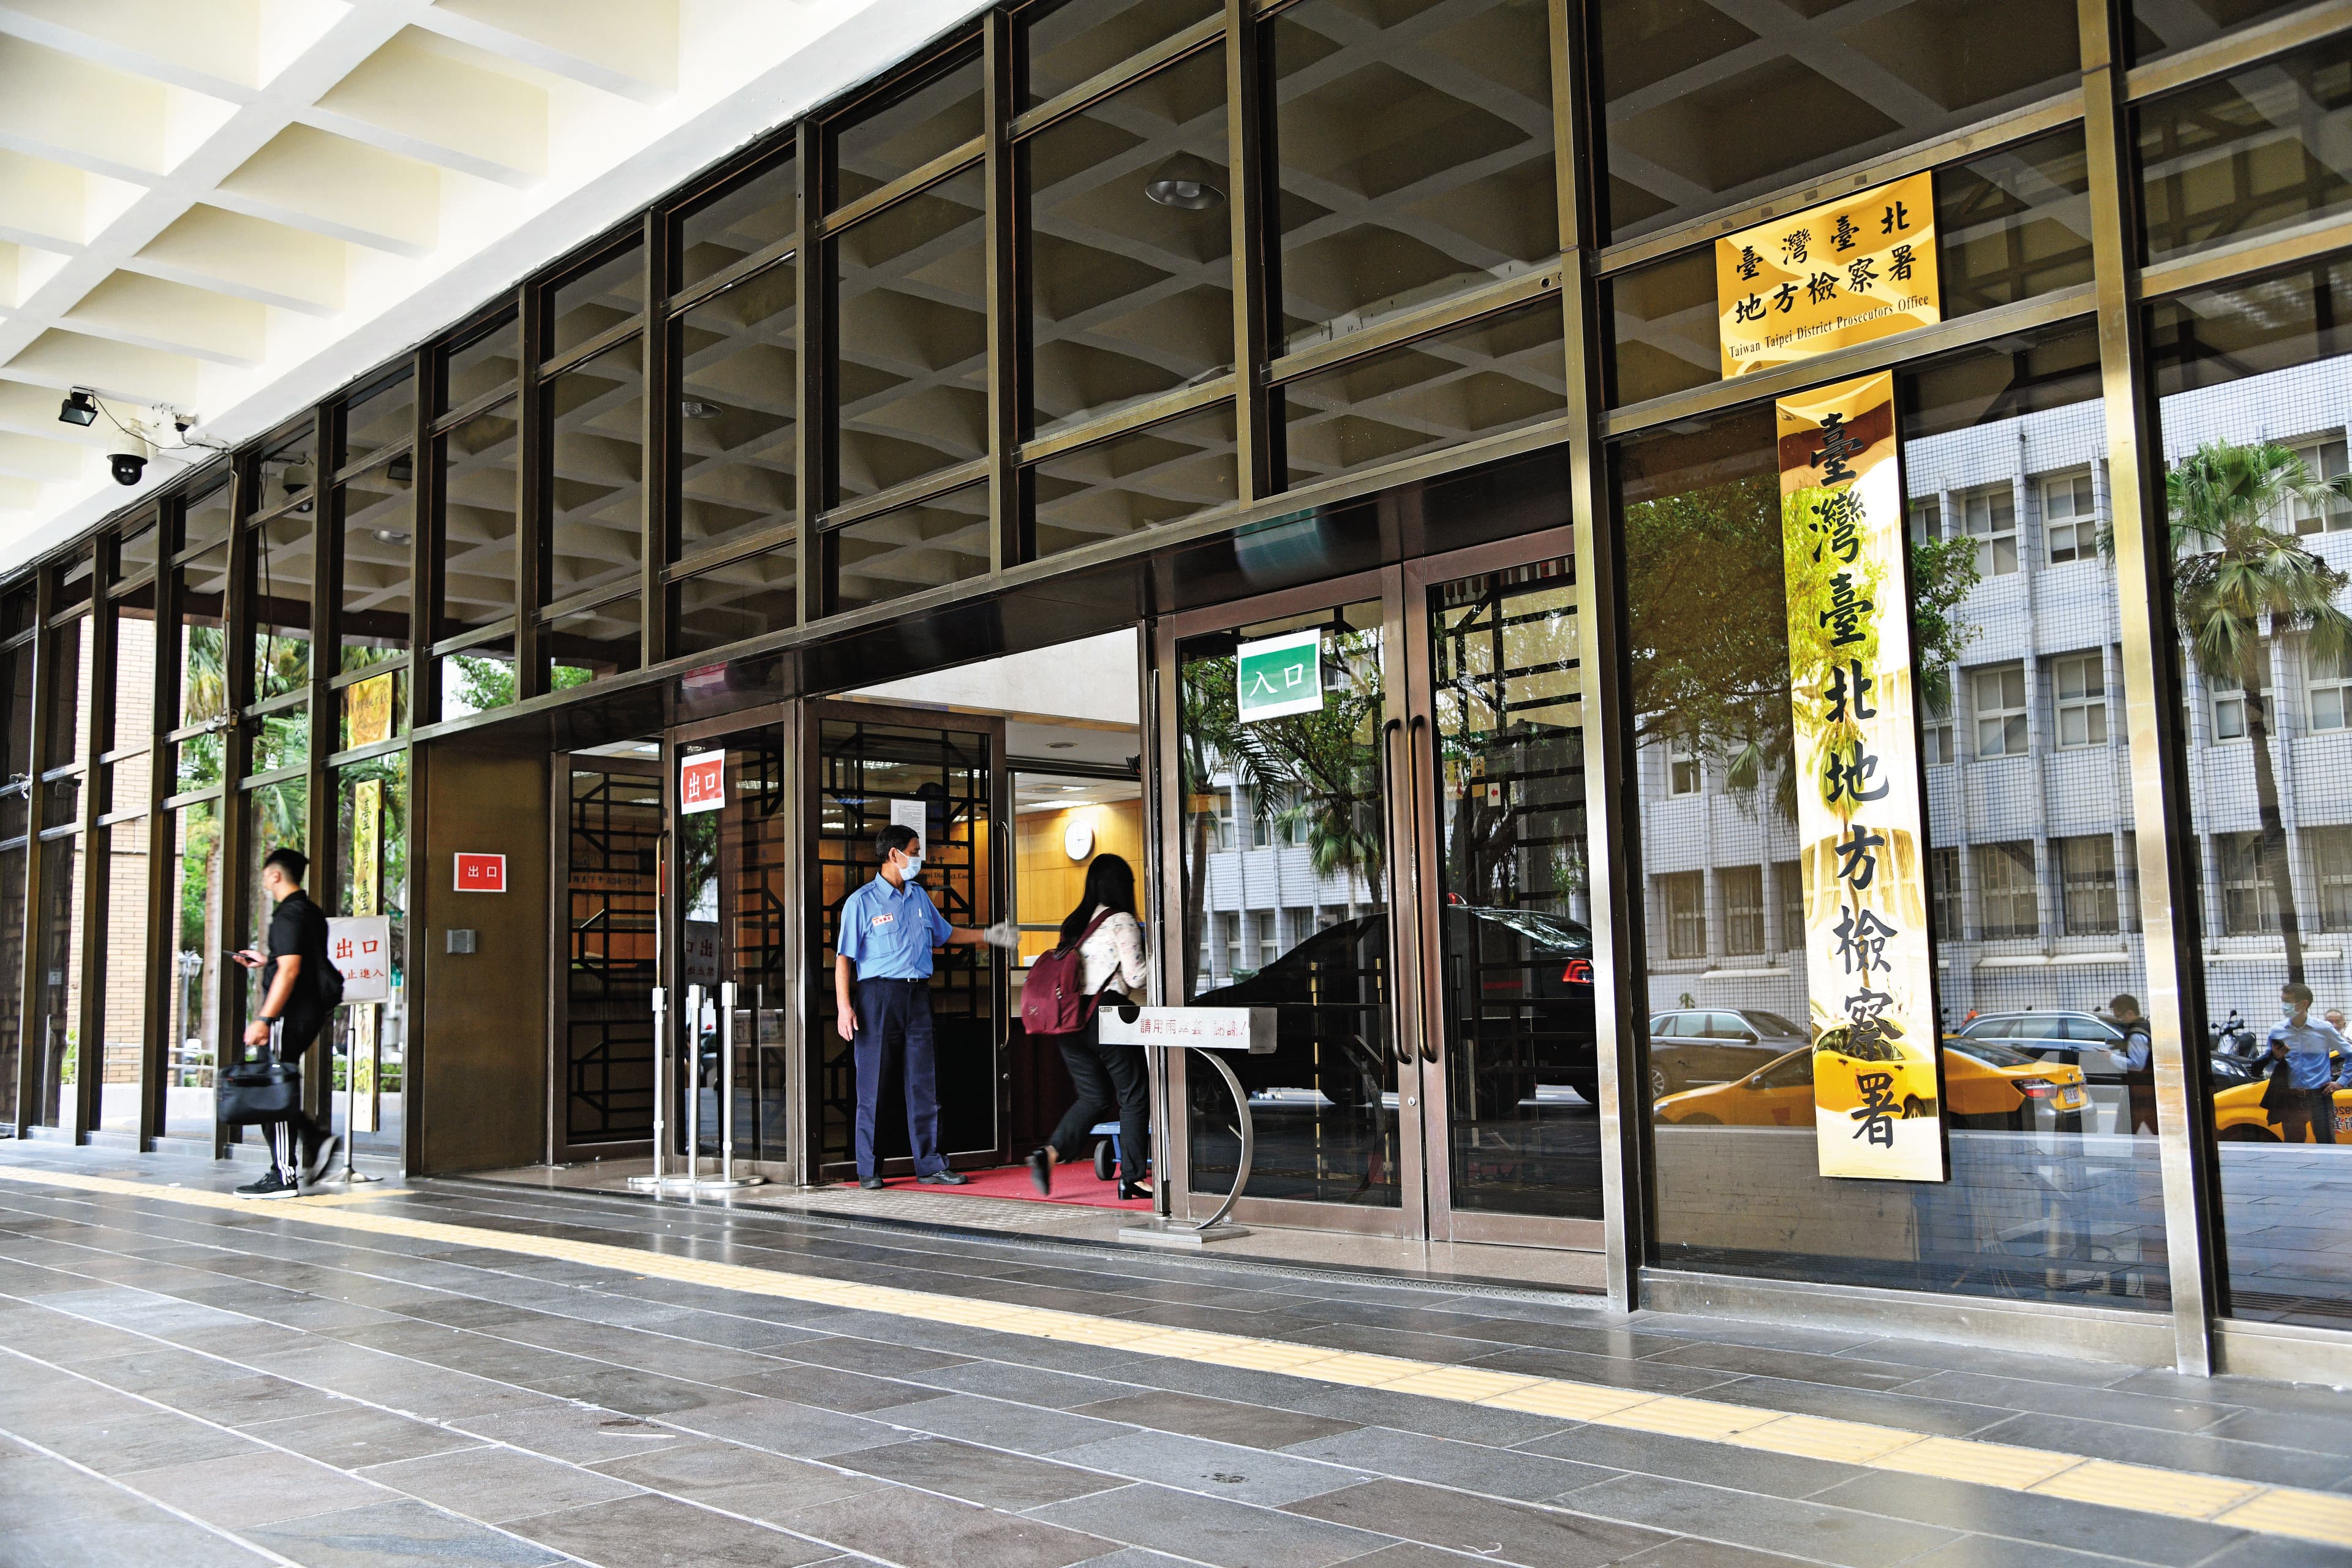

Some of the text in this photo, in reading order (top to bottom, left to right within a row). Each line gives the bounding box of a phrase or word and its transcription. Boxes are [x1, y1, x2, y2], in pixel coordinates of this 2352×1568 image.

[1736, 200, 1910, 281] 臺灣臺北
[1735, 244, 1917, 324] 地方檢察署
[1729, 294, 1929, 358] Taiwan Taipei District Prosecutors Office
[1249, 663, 1304, 698] 入口
[688, 772, 716, 799] 出口
[1809, 412, 1903, 1150] 臺灣臺北地方檢察署
[468, 865, 497, 878] 出口
[336, 938, 379, 959] 出口
[338, 968, 385, 980] 止進入
